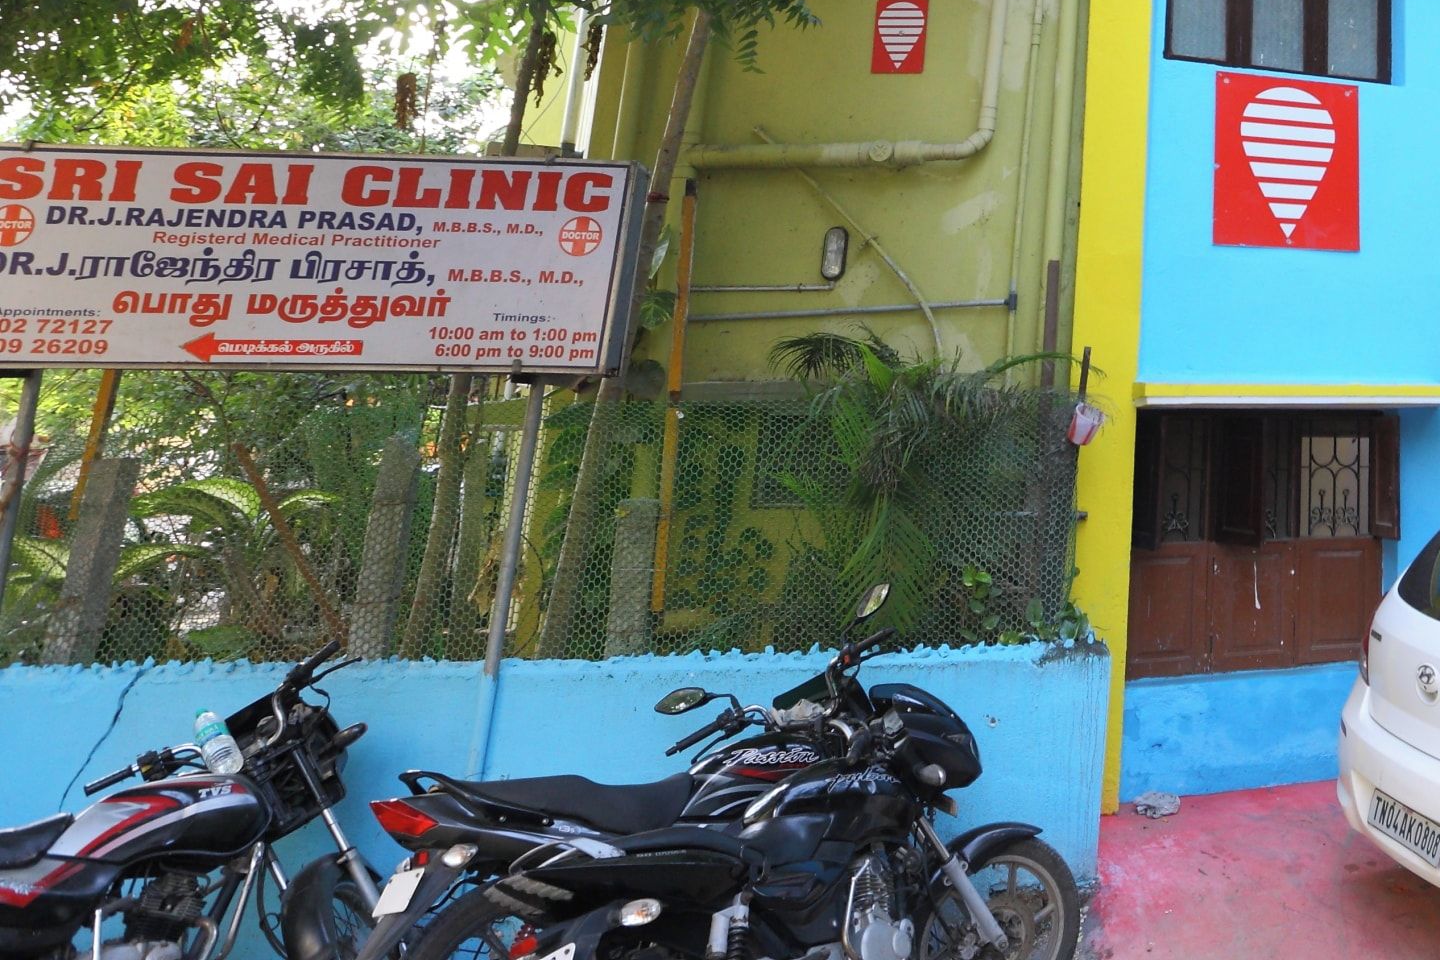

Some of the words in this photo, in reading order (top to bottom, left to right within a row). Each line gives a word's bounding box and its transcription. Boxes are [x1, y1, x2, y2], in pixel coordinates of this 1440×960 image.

[0, 157, 143, 201] SRI
[170, 161, 314, 205] SAI
[341, 165, 613, 212] CLINIC
[46, 205, 287, 229] DR.J.RAJENDRA
[298, 210, 423, 236] PRASAD,
[433, 221, 501, 235] M.B.B.S.,
[506, 223, 544, 236] M.D.,
[152, 231, 246, 247] Registerd
[252, 232, 325, 246] Medical
[331, 234, 441, 249] Practitioner
[561, 231, 600, 240] DOCTOR
[447, 268, 532, 286] M.B.B.S.,
[538, 270, 584, 287] M.D.,
[0, 306, 101, 317] ppointments:
[112, 290, 233, 327] பொது
[246, 287, 452, 329] மருத்துவர்
[36, 319, 114, 335] 72127
[429, 326, 474, 340] 10:00
[479, 329, 504, 341] am
[510, 328, 527, 341] to
[532, 327, 567, 342] 1:00
[571, 330, 598, 344] pm
[30, 339, 108, 355] 26209
[435, 343, 471, 357] 6:00
[475, 345, 502, 360] pm
[507, 344, 524, 358] to
[528, 344, 565, 359] 9:00
[568, 347, 595, 361] pm
[199, 785, 232, 798] TVS
[1373, 796, 1440, 858] TN04AK0808
